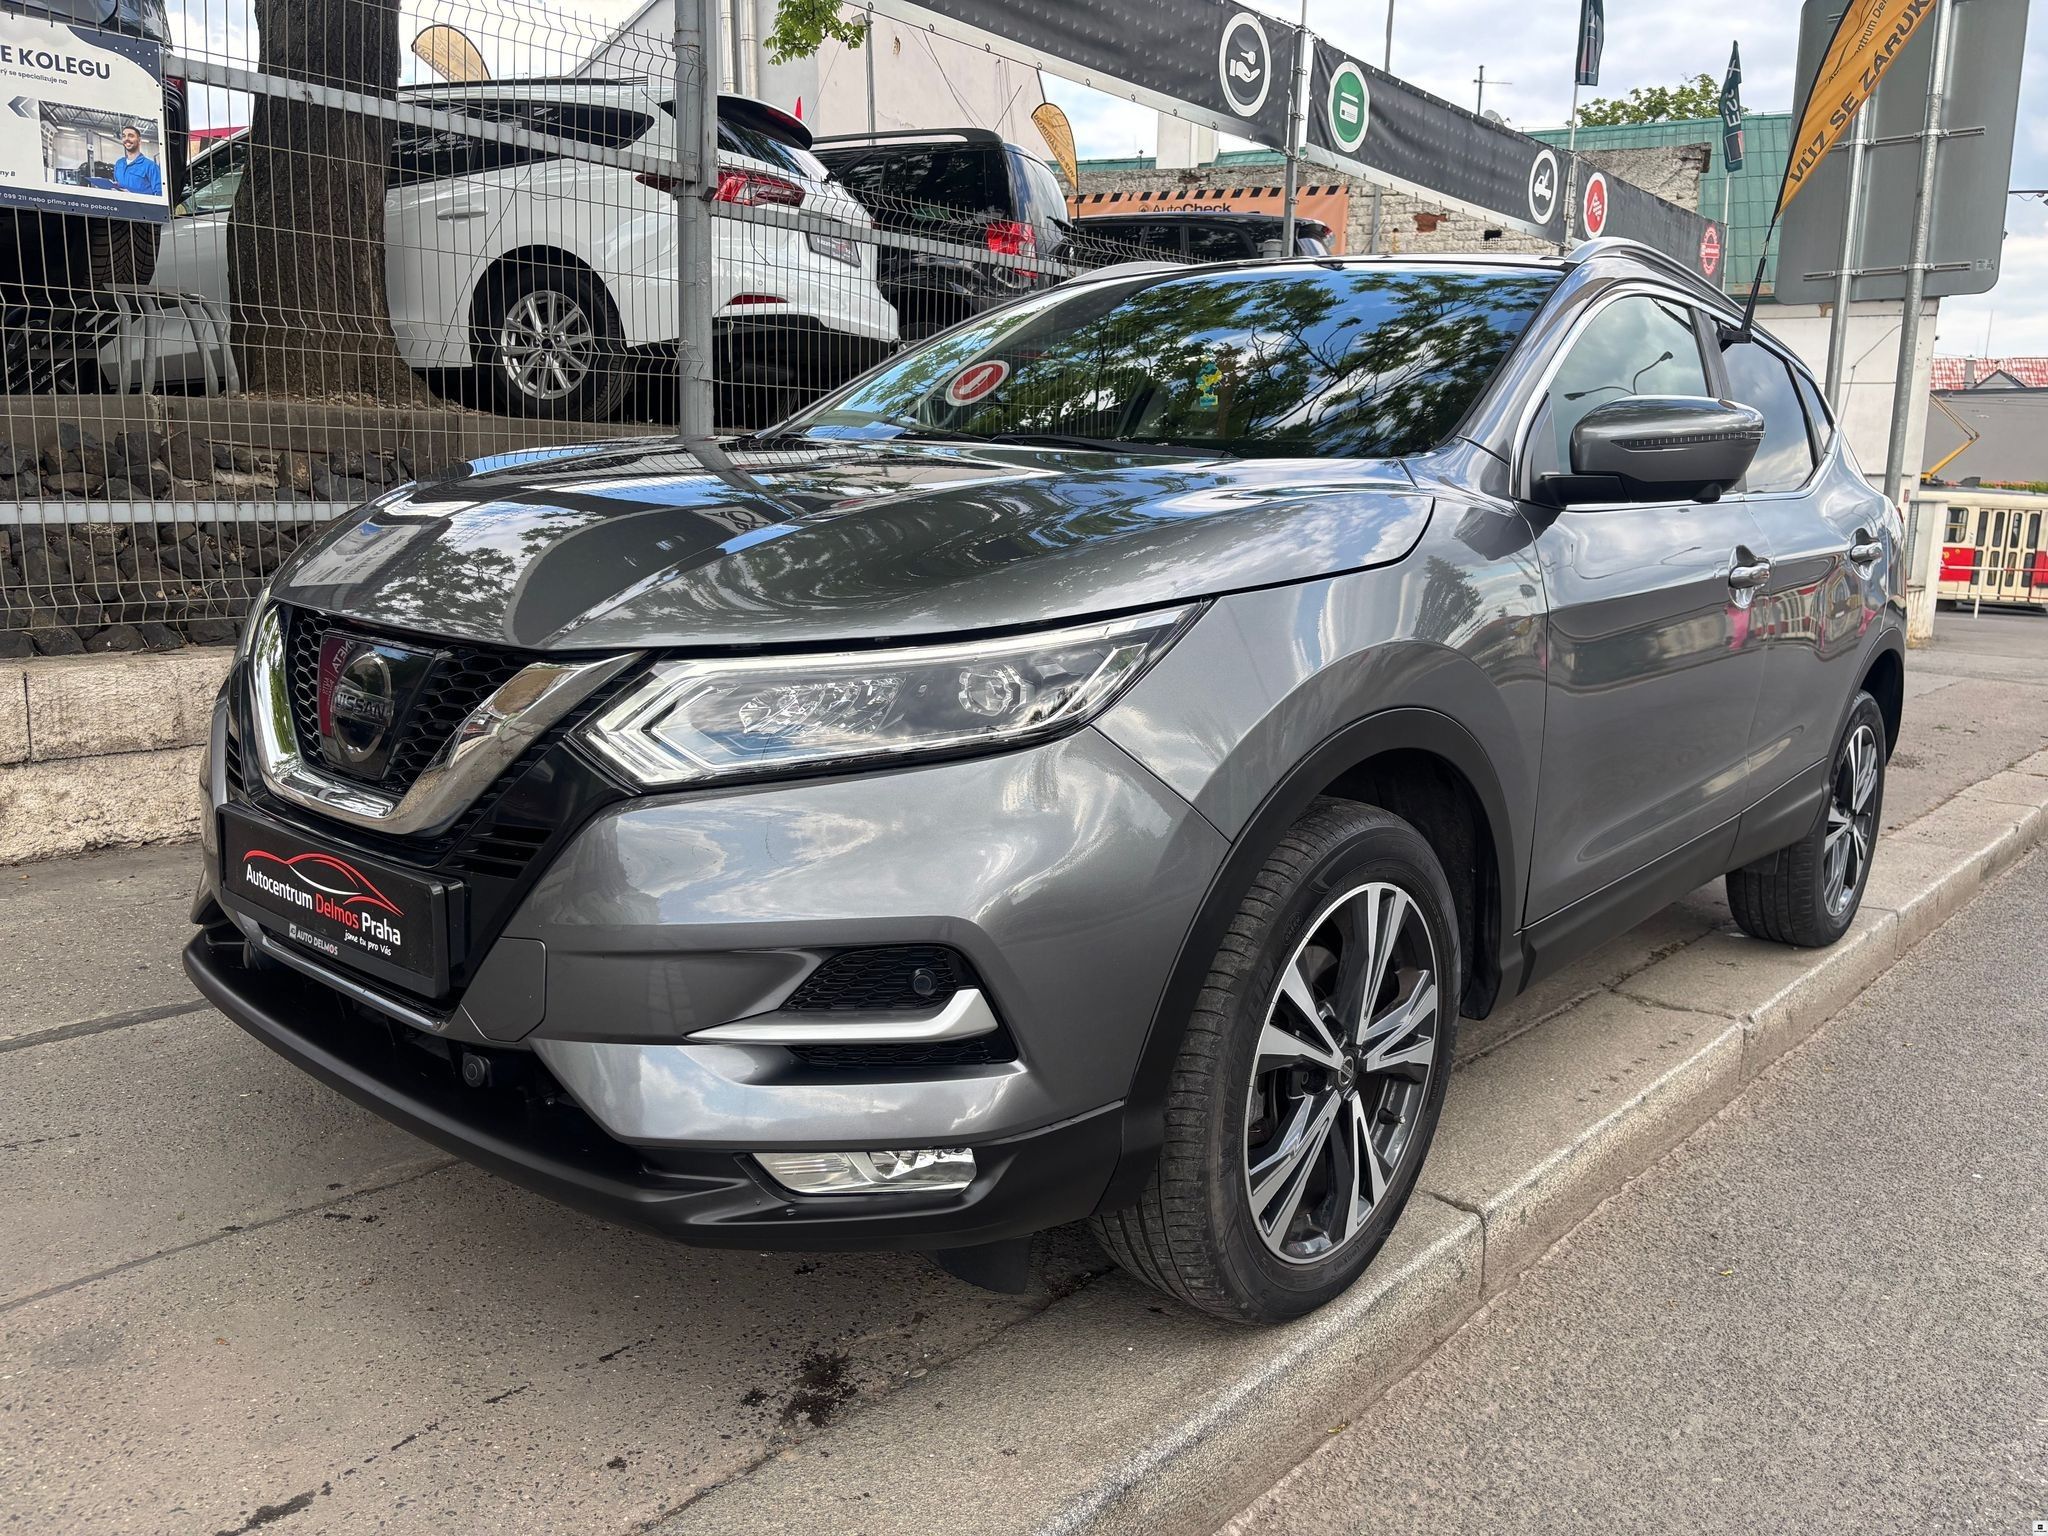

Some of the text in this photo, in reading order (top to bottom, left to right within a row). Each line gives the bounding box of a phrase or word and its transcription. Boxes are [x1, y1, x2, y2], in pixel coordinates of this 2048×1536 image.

[18, 48, 111, 80] KOLEGU
[18, 72, 58, 84] specializuje
[1790, 130, 1828, 182] VŮZ
[1830, 91, 1859, 130] SE
[1153, 203, 1232, 212] AutoCheck
[246, 863, 401, 946] Autocentrum Delmos Praha
[297, 929, 339, 956] AUTO DELMOS
[360, 936, 367, 947] tu
[367, 941, 379, 951] pro
